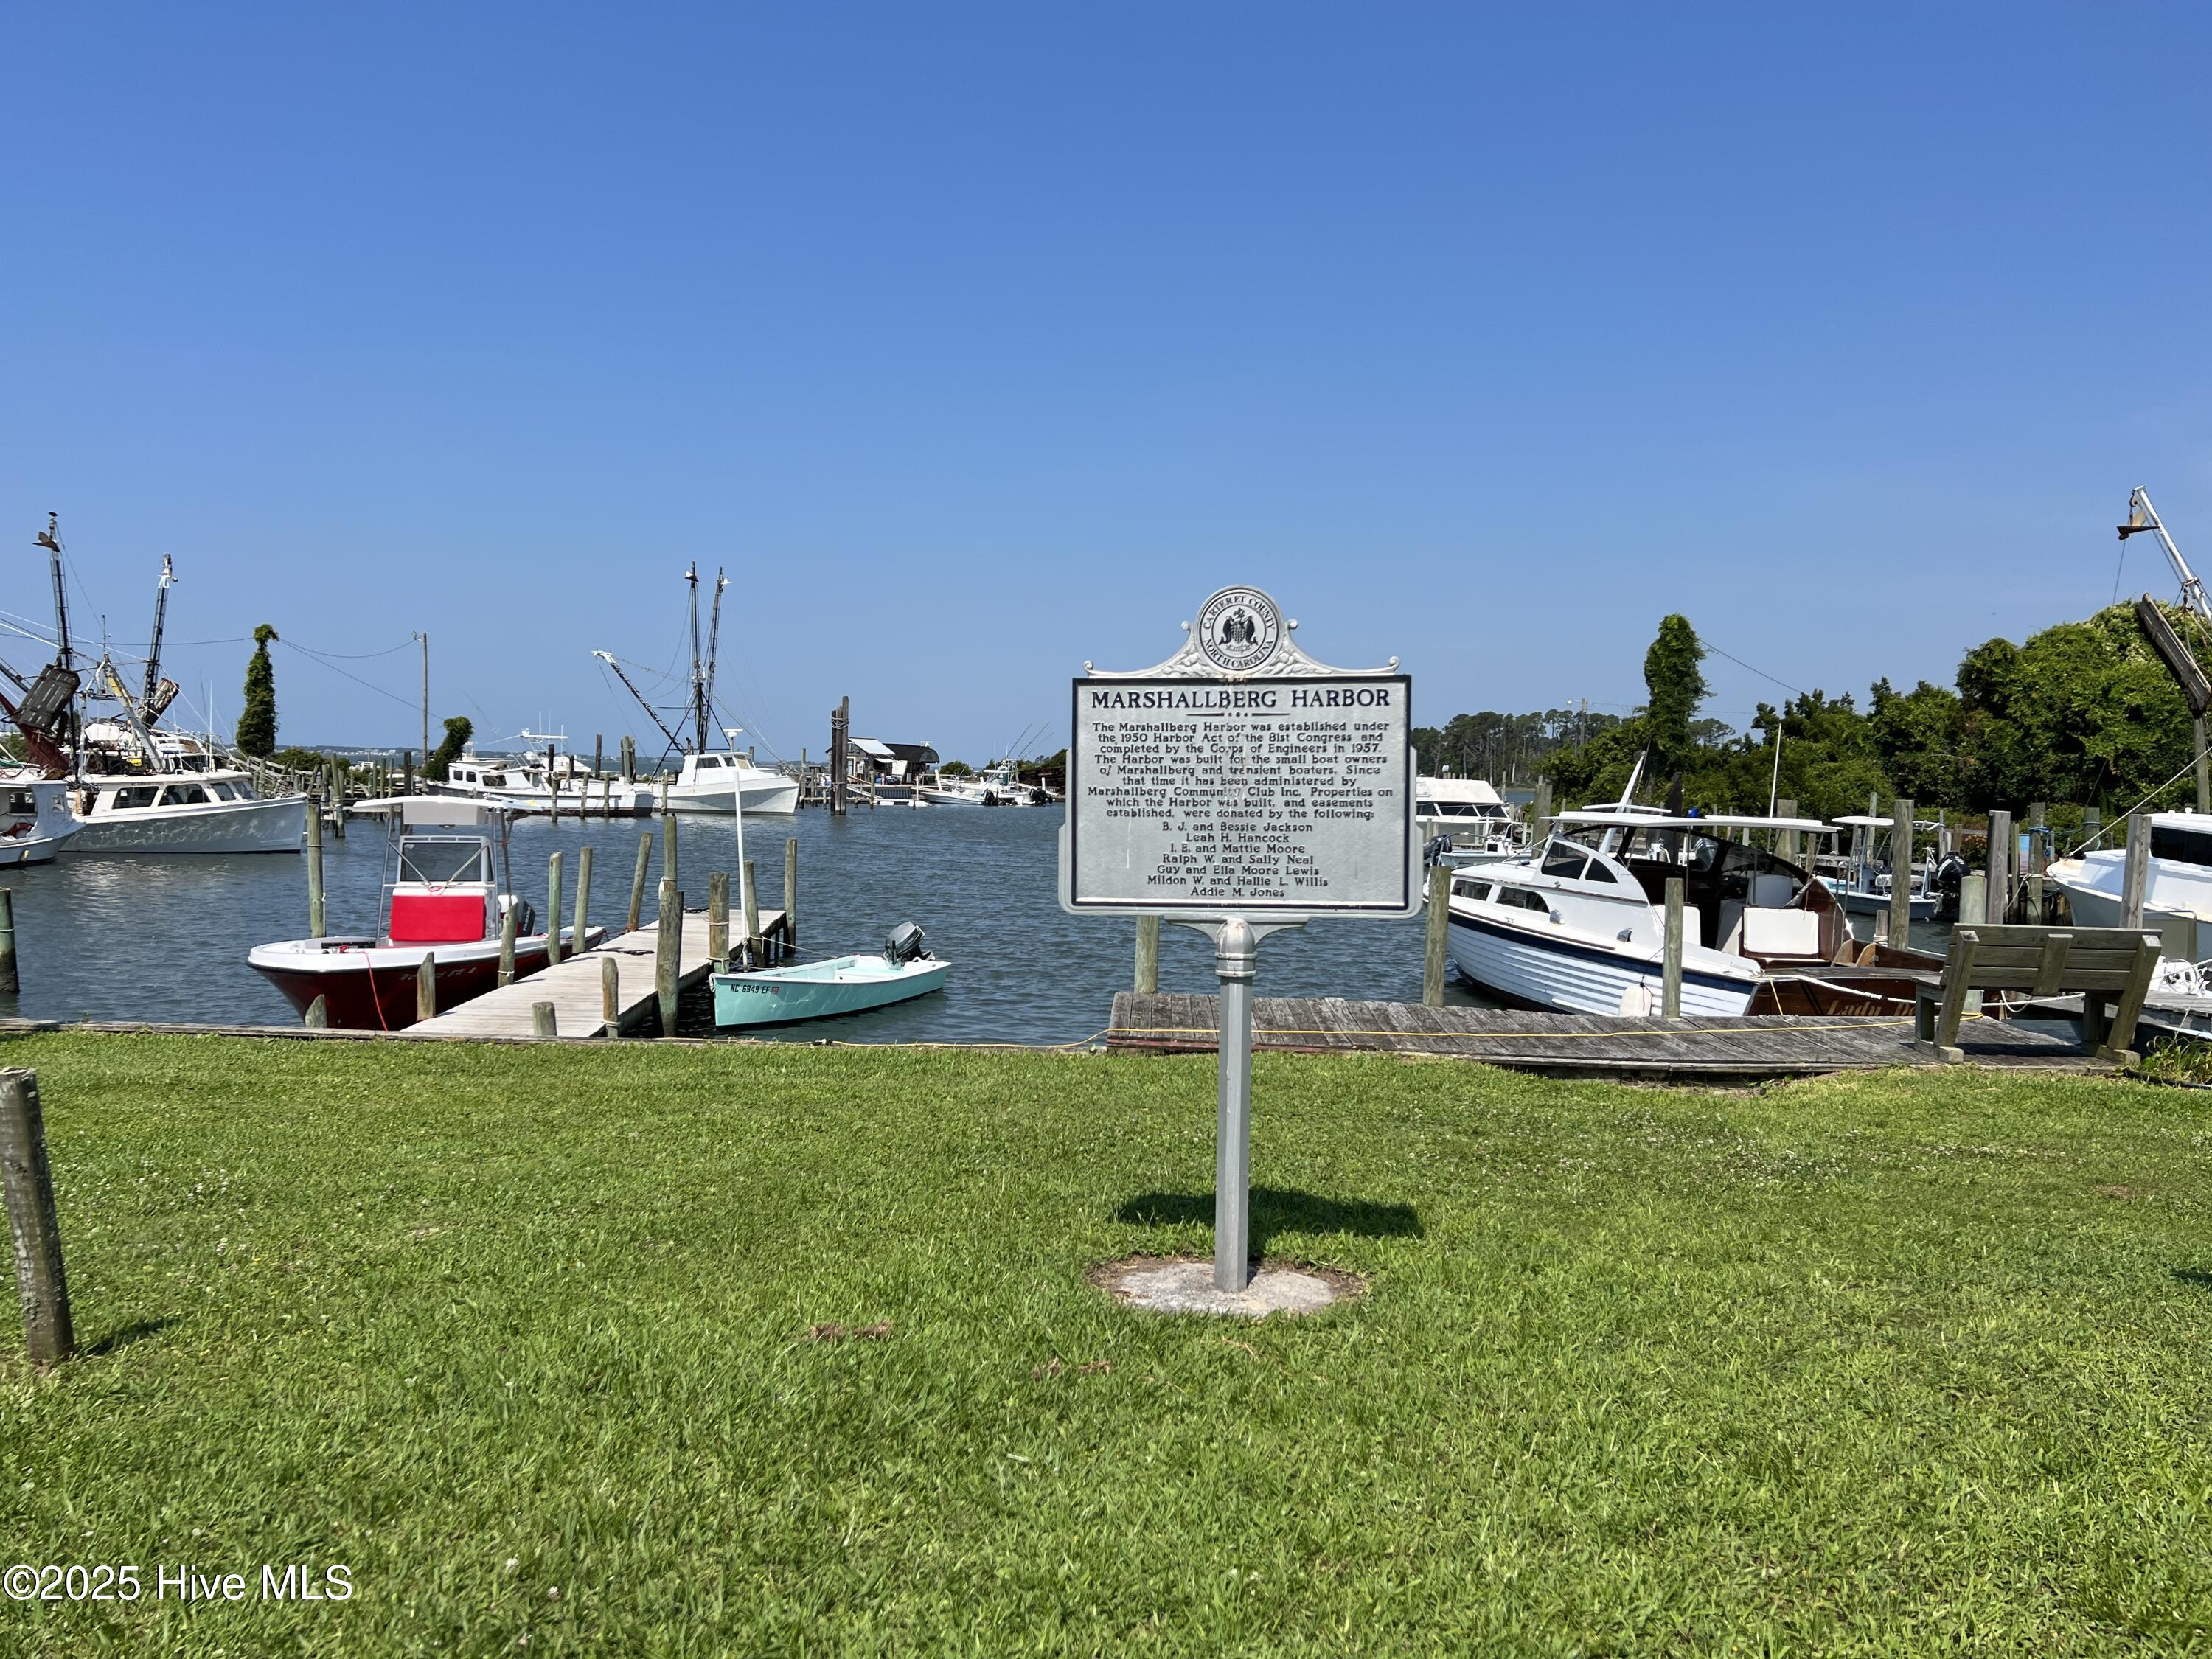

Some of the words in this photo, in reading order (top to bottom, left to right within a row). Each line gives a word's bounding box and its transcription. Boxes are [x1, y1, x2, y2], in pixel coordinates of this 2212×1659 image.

[1203, 596, 1245, 629] CARTERET
[1249, 598, 1275, 629] COUNTY
[1204, 638, 1229, 667] NORTH
[1231, 641, 1273, 667] CAROLINA
[1092, 690, 1277, 709] MARSHALLBERG
[1290, 689, 1390, 708] HARBOR
[1093, 723, 1115, 731] The
[1119, 723, 1197, 734] Marshallberg
[1204, 722, 1246, 731] Harbor
[1279, 722, 1346, 731] established
[1354, 722, 1389, 731] under
[1098, 734, 1116, 742] the
[1121, 733, 1147, 742] 1950
[1153, 733, 1194, 742] Harbor
[1202, 733, 1222, 742] Act
[1228, 733, 1240, 742] of
[1245, 733, 1263, 742] the
[1269, 733, 1290, 742] 81st
[1297, 733, 1352, 744] Congress
[1361, 733, 1382, 742] and
[1100, 745, 1159, 755] completed
[1166, 745, 1180, 754] by
[1186, 745, 1203, 753] the
[1211, 743, 1243, 756] Corps
[1251, 744, 1262, 753] of
[1268, 744, 1326, 755] Engineers
[1334, 743, 1345, 752] in
[1352, 743, 1381, 752] 1957.
[1094, 755, 1116, 764] The
[1122, 755, 1164, 764] Harbor
[1196, 755, 1222, 764] built
[1229, 755, 1246, 764] for
[1252, 755, 1270, 763] the
[1276, 755, 1306, 763] small
[1312, 755, 1338, 763] boat
[1099, 765, 1111, 776] of
[1117, 765, 1195, 776] Marshallberg
[1202, 766, 1222, 774] and
[1229, 766, 1281, 774] transient
[1290, 766, 1337, 774] boaters.
[1346, 765, 1380, 774] Since
[1122, 776, 1145, 785] that
[1151, 776, 1175, 785] time
[1181, 776, 1189, 785] it
[1195, 776, 1214, 785] has
[1220, 776, 1248, 785] been
[1254, 776, 1334, 785] administered
[1342, 776, 1357, 787] by
[1088, 787, 1166, 798] Marshallberg
[1174, 787, 1241, 797] Community
[1248, 787, 1275, 796] Club
[1281, 787, 1301, 796] Inc.
[1310, 787, 1372, 798] Properties
[1107, 798, 1139, 807] which
[1145, 798, 1163, 807] the
[1169, 798, 1211, 807] Harbor
[1284, 799, 1305, 807] and
[1217, 809, 1262, 818] donated
[1269, 809, 1283, 819] by
[1289, 809, 1307, 818] the
[1314, 809, 1374, 821] following:
[1162, 822, 1172, 831] B.
[1178, 823, 1187, 831] J.
[1193, 823, 1213, 831] and
[1220, 822, 1256, 832] Bessie
[1263, 823, 1313, 832] Jackson
[1186, 833, 1214, 842] Leah
[1220, 833, 1232, 842] H.
[1238, 833, 1290, 843] Hancock
[1170, 844, 1179, 852] I.
[1182, 844, 1191, 852] E.
[1196, 844, 1216, 853] and
[1222, 844, 1261, 853] Mattie
[1267, 844, 1306, 854] Moore
[1163, 854, 1197, 864] Ralph
[1204, 855, 1215, 863] W.
[1222, 855, 1242, 863] and
[1249, 855, 1279, 865] Sally
[1287, 855, 1313, 864] Neal
[1157, 865, 1180, 875] Guy
[1186, 866, 1206, 874] and
[1214, 866, 1234, 874] Ella
[1242, 866, 1279, 874] Moore
[1285, 866, 1319, 875] Lewis
[1147, 875, 1186, 885] Mildon
[1193, 876, 1204, 885] W.
[1210, 876, 1231, 885] and
[1237, 877, 1271, 886] Hallie
[1279, 877, 1288, 886] L.
[1295, 877, 1329, 886] Willis
[1190, 887, 1225, 896] Addie
[1232, 887, 1245, 896] M.
[1250, 888, 1285, 897] Jones
[731, 984, 739, 992] NC
[742, 985, 759, 993] 6949
[762, 986, 771, 994] EF
